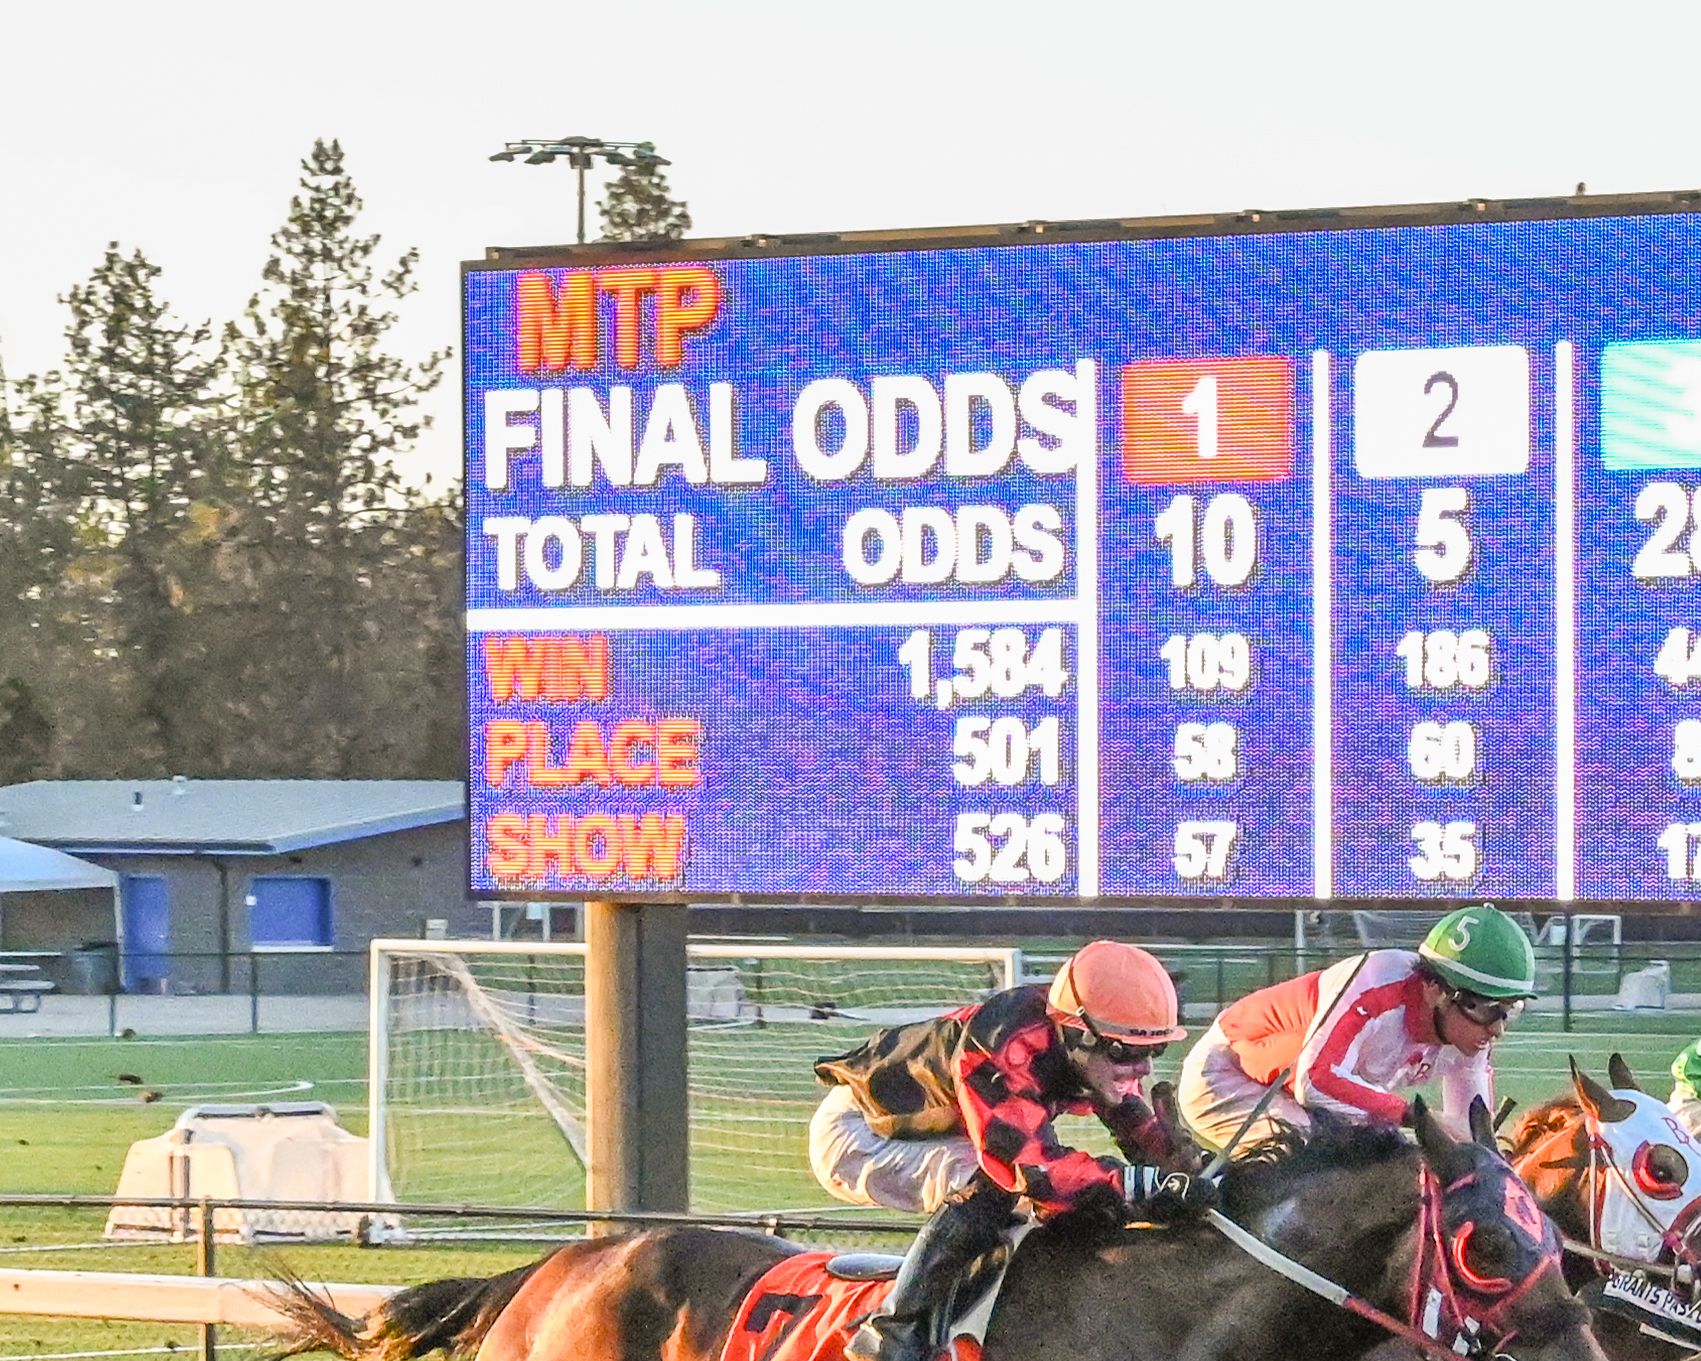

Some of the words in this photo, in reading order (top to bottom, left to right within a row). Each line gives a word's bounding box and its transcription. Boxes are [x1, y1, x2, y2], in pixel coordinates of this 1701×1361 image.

[515, 265, 722, 371] MTP
[485, 383, 766, 488] FINAL
[792, 369, 1078, 484] ODDS
[1183, 376, 1218, 458] 1
[1422, 370, 1460, 448] 2
[484, 514, 720, 590] TOTAL
[843, 504, 1064, 584] ODDS
[1156, 494, 1255, 586] 10
[1415, 488, 1470, 581] 5
[483, 633, 609, 702] WIN
[899, 628, 1068, 709] 1,584
[1161, 634, 1249, 689] 109
[1397, 630, 1489, 687] 186
[484, 718, 703, 787] PLACE
[953, 717, 1058, 785] 501
[1173, 723, 1236, 779] 58
[1409, 722, 1474, 778] 60
[485, 812, 688, 880] SHOW
[954, 813, 1065, 882] 526
[1173, 821, 1236, 877] 57
[1409, 821, 1475, 879] 35
[1449, 915, 1479, 951] 5
